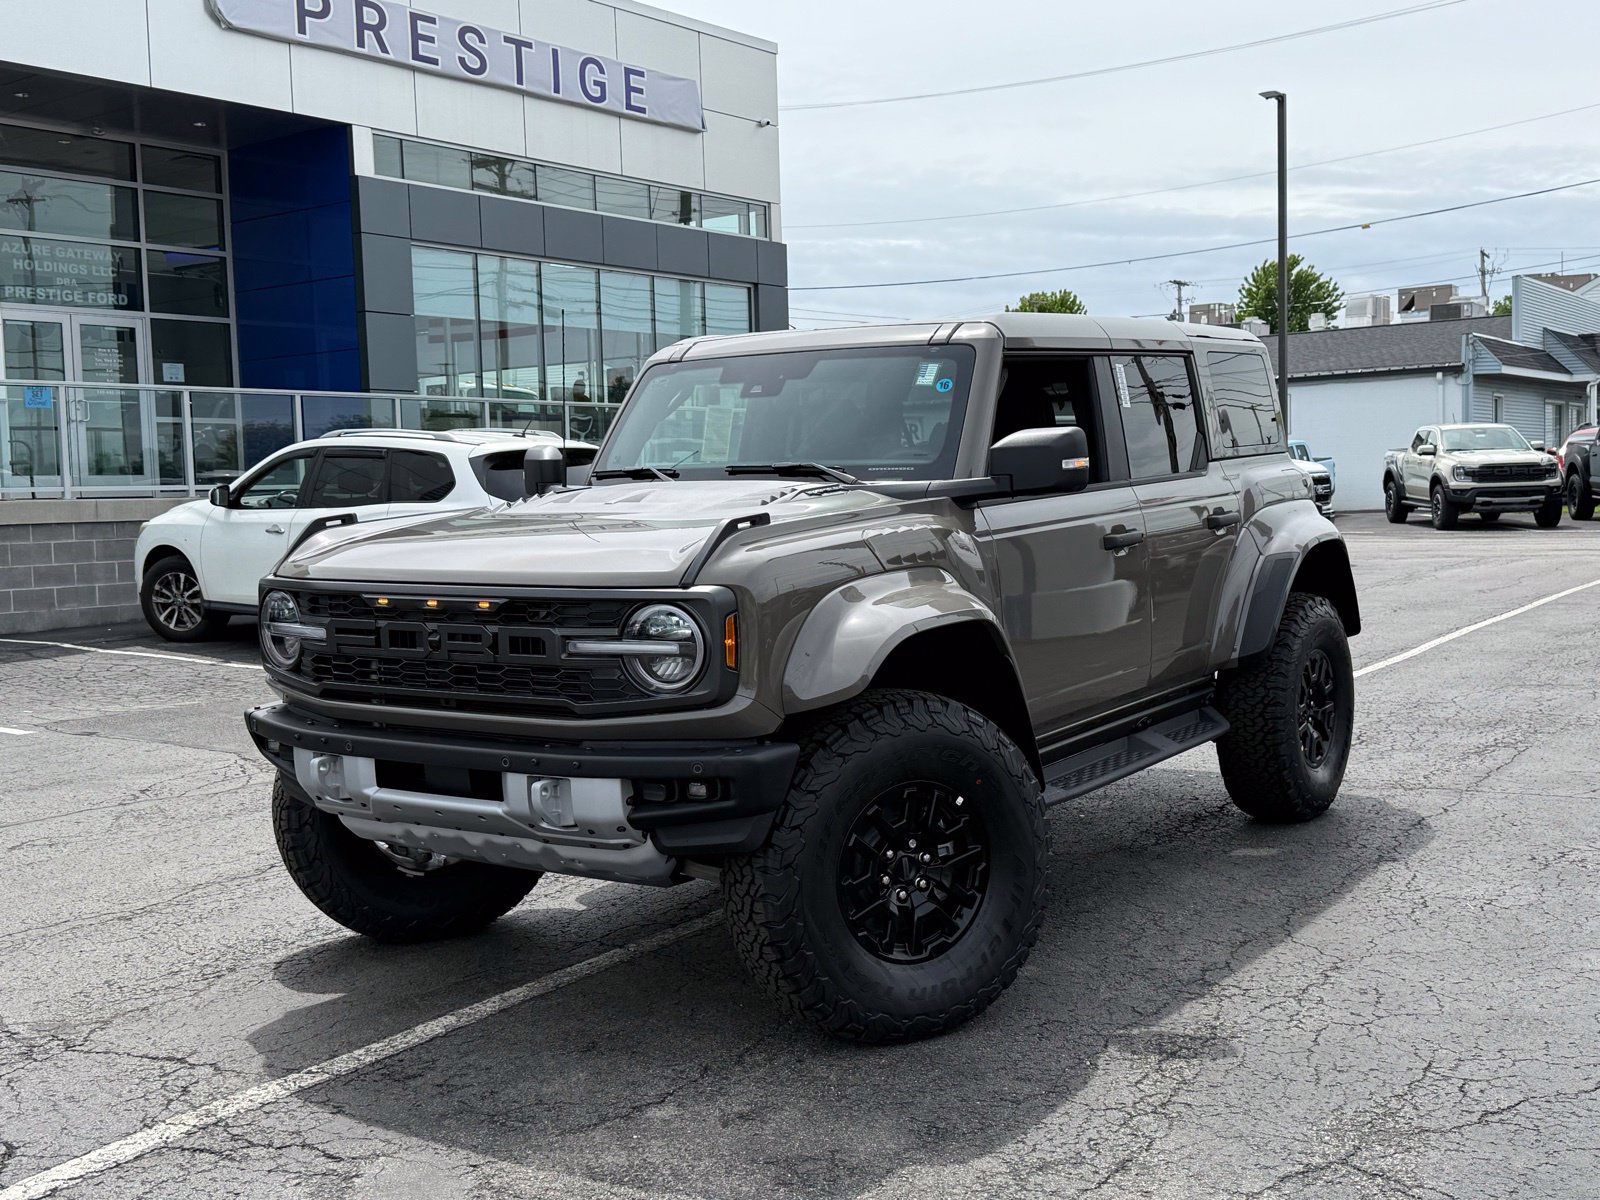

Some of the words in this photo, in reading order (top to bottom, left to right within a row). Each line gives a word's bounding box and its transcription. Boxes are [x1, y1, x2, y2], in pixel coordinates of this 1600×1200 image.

[295, 0, 648, 115] PRESTIGE
[1, 241, 51, 257] AZURE
[56, 247, 122, 262] GATEWAY
[13, 258, 88, 275] HOLDINGS
[92, 265, 118, 277] LLC
[4, 285, 83, 302] PRESTIGE
[87, 291, 128, 305] FORD
[939, 381, 950, 390] 16
[328, 617, 558, 666] FORD
